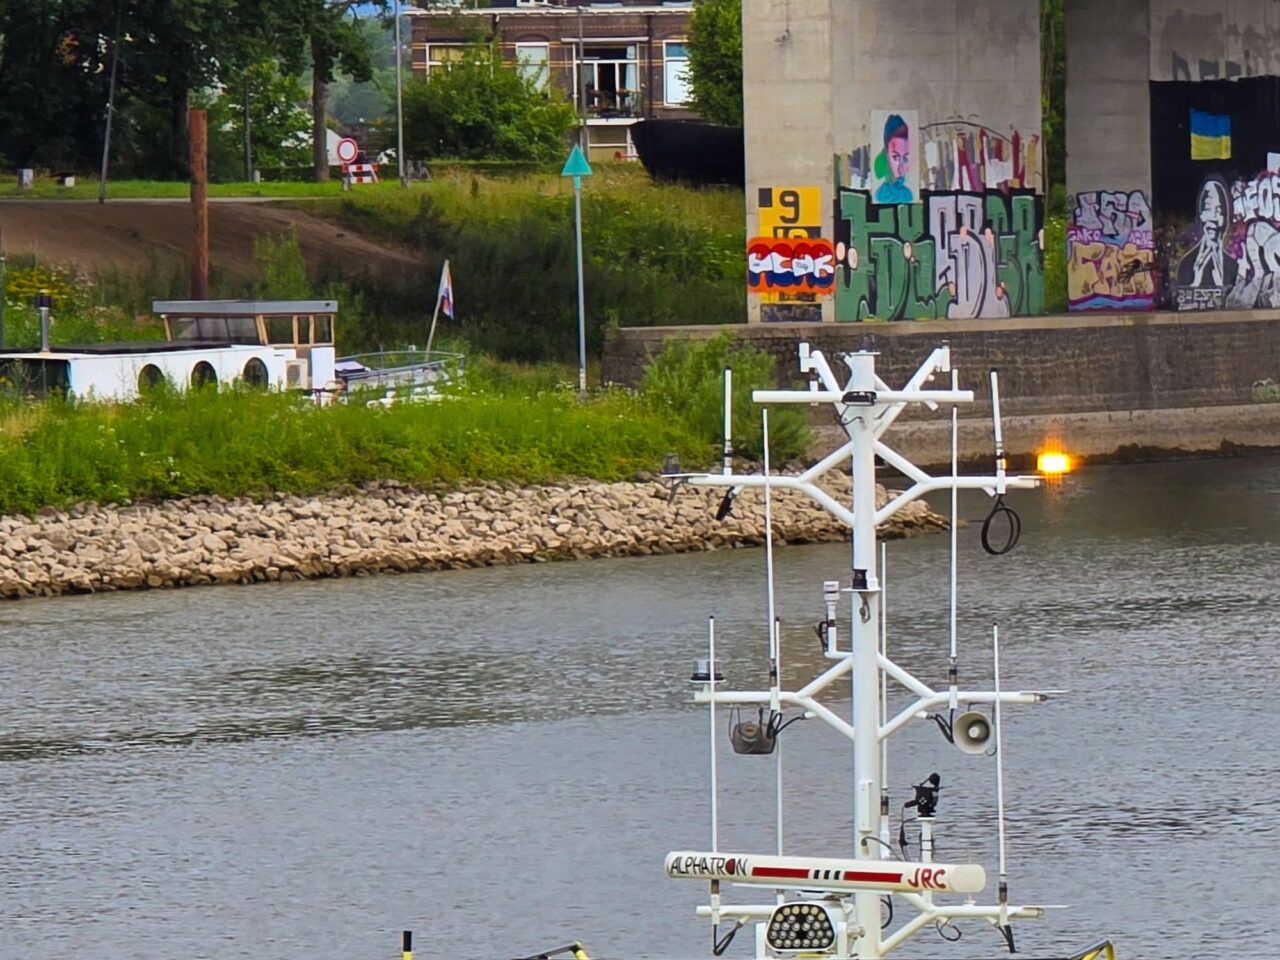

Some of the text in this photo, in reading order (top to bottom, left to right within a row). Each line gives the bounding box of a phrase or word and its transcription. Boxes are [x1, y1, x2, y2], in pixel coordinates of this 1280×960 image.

[778, 190, 799, 224] 9
[670, 856, 748, 876] ALPHATRON
[907, 867, 947, 889] JRC
